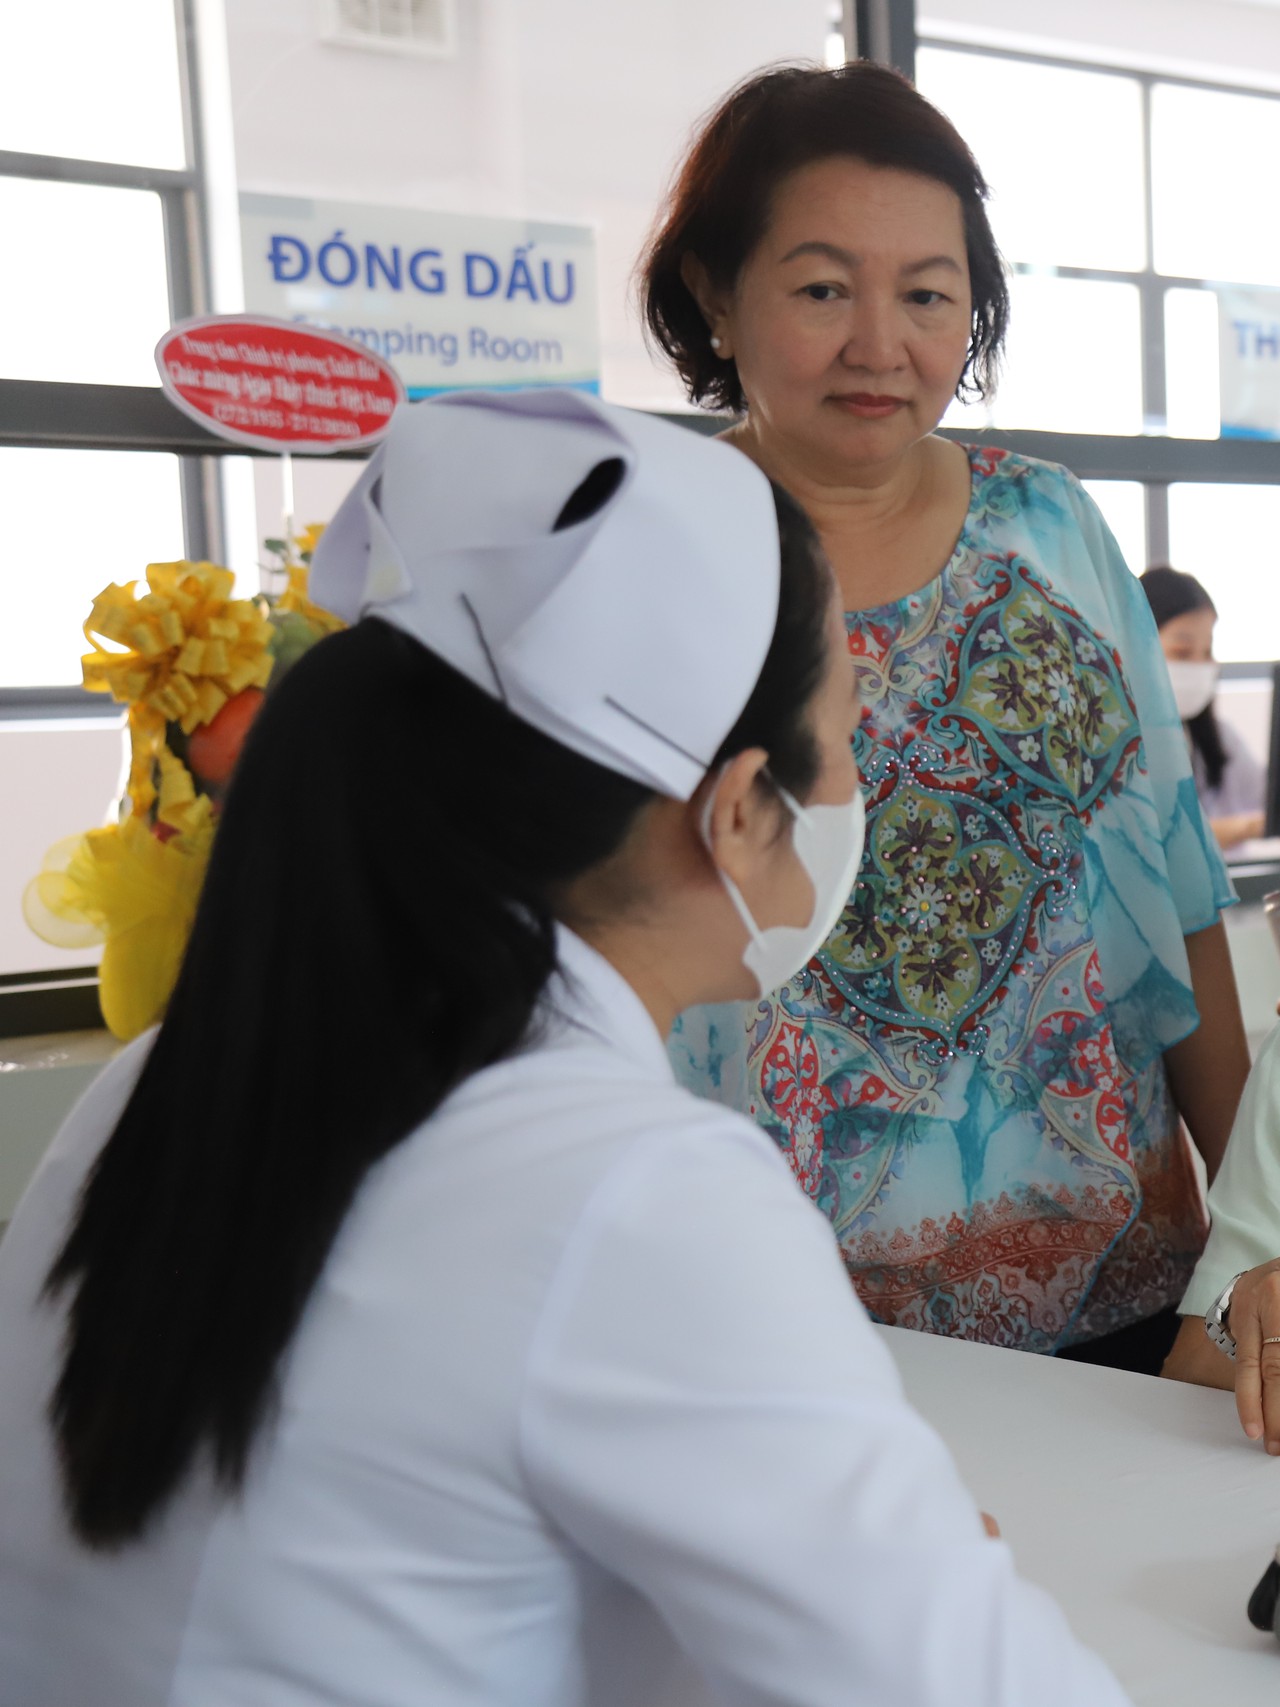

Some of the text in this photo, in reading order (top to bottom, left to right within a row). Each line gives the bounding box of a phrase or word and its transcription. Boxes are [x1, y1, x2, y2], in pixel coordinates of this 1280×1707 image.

[267, 229, 576, 305] ĐÓNG DẤU
[292, 313, 564, 366] mping Room
